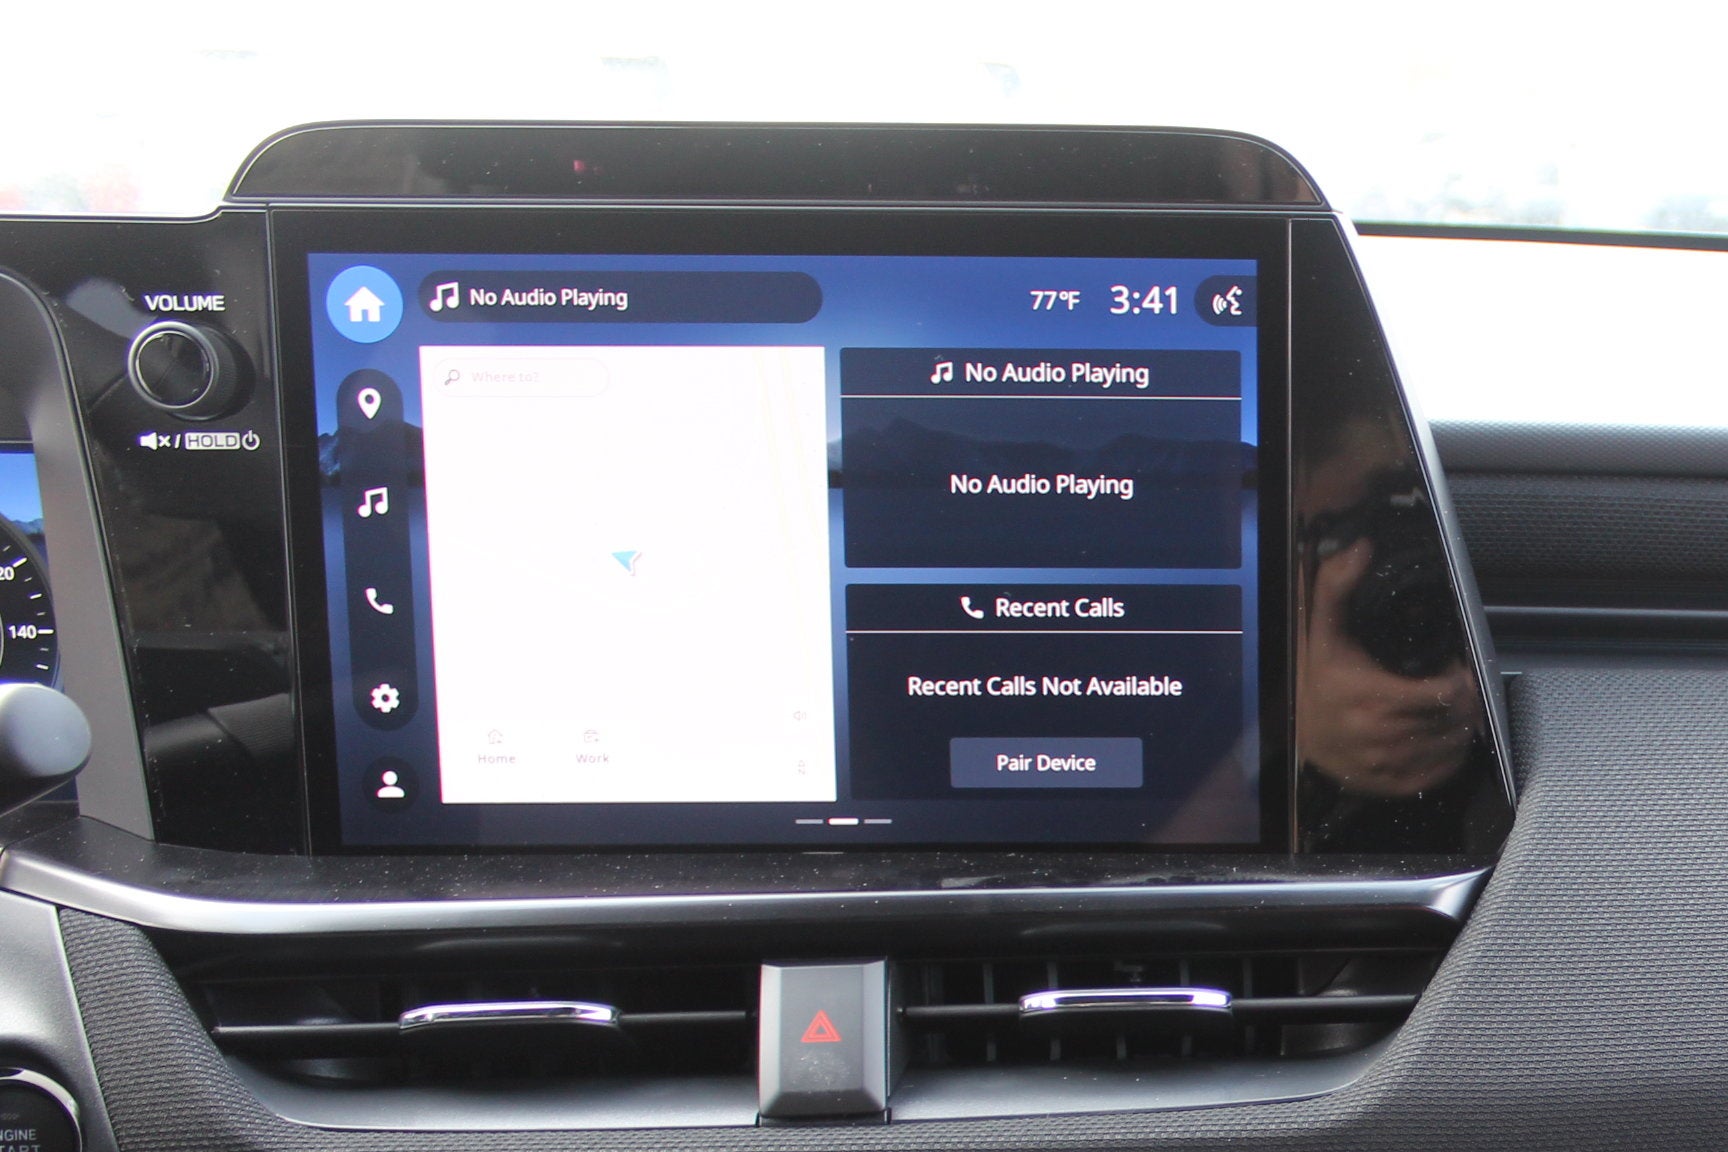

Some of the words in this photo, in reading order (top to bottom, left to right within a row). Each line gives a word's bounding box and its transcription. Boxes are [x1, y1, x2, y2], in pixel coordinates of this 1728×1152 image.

[144, 294, 226, 312] VOLUME
[469, 288, 497, 306] No
[501, 288, 557, 306] Audio
[561, 288, 628, 310] Playing
[1109, 284, 1178, 315] 3:41
[472, 372, 515, 382] Where
[519, 372, 539, 382] to?
[965, 362, 997, 382] No
[1002, 362, 1066, 382] Audio
[1071, 362, 1150, 388] Playing
[187, 434, 238, 448] HOLD
[950, 474, 982, 494] No
[986, 474, 1050, 494] Audio
[1056, 474, 1134, 500] Playing
[995, 598, 1070, 618] Recent
[1074, 597, 1125, 618] Calls
[8, 625, 37, 639] 140
[908, 676, 982, 696] Recent
[986, 676, 1036, 696] Calls
[1042, 676, 1082, 696] Not
[1086, 676, 1182, 696] Available
[477, 754, 516, 764] Home
[576, 753, 610, 764] Work
[996, 754, 1032, 772] Pair
[1036, 754, 1096, 772] Device
